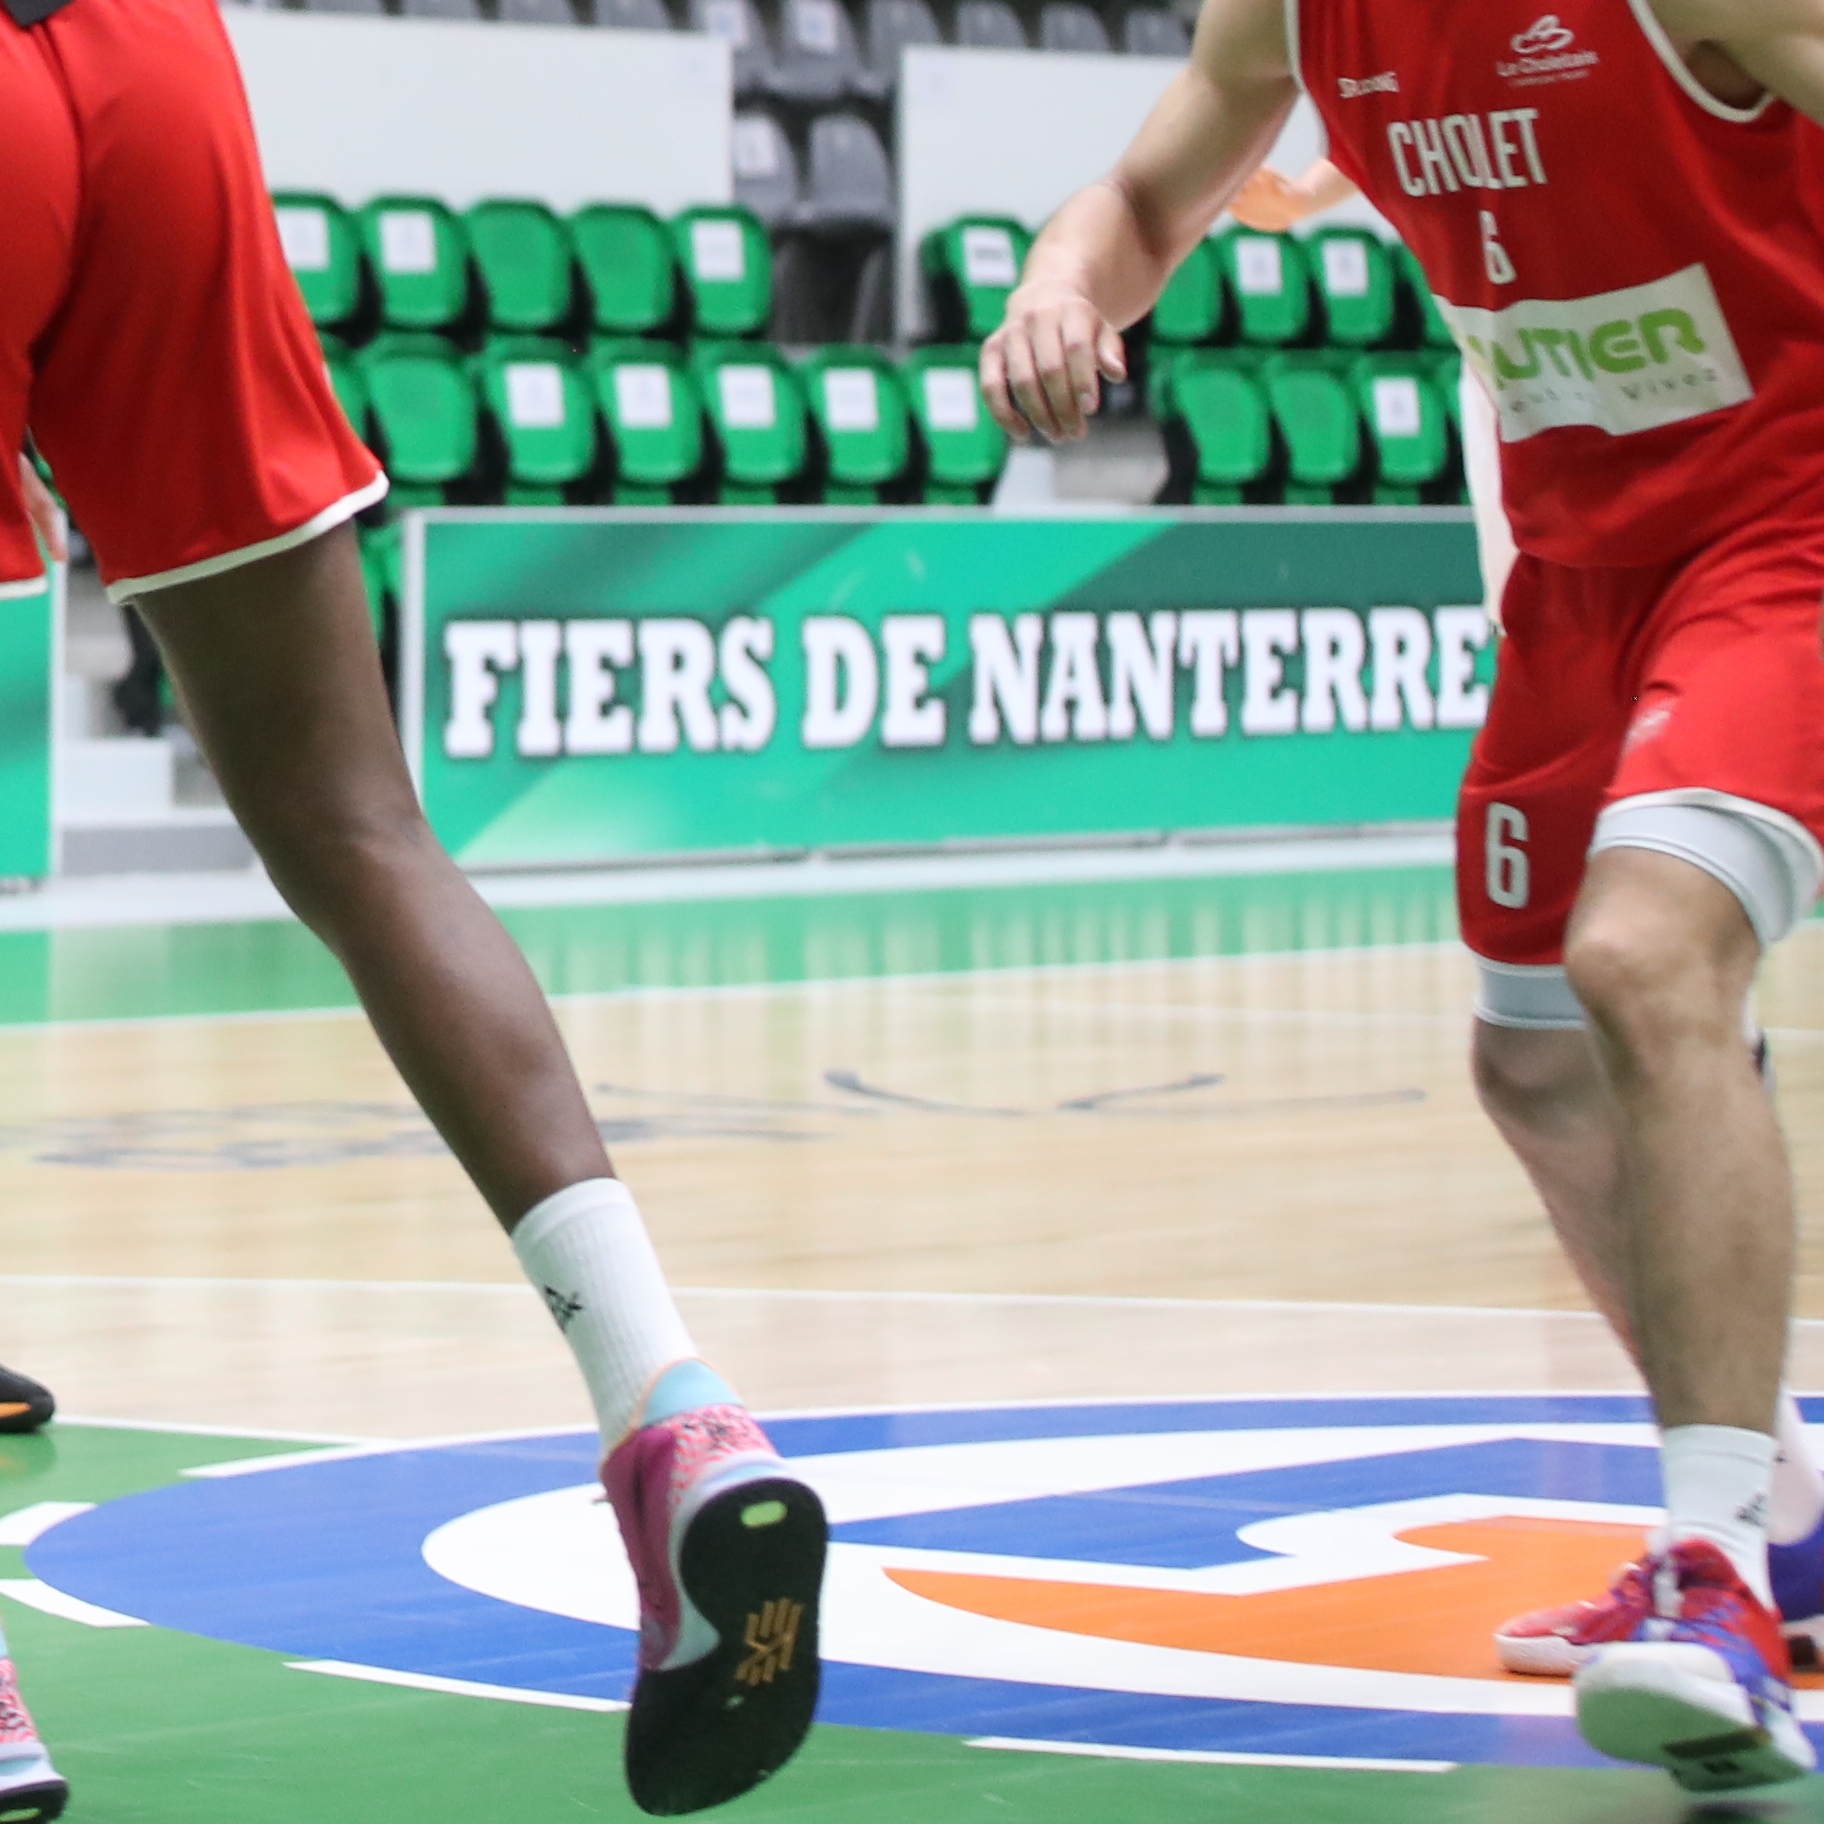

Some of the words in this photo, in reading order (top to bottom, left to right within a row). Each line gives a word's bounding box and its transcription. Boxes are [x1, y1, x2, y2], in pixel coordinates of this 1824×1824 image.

[1387, 107, 1549, 197] CHOLET
[1479, 209, 1518, 285] 6
[443, 617, 776, 759] FIERS
[801, 613, 947, 749] DE
[967, 606, 1492, 745] NANTERRE
[1485, 800, 1530, 911] 6
